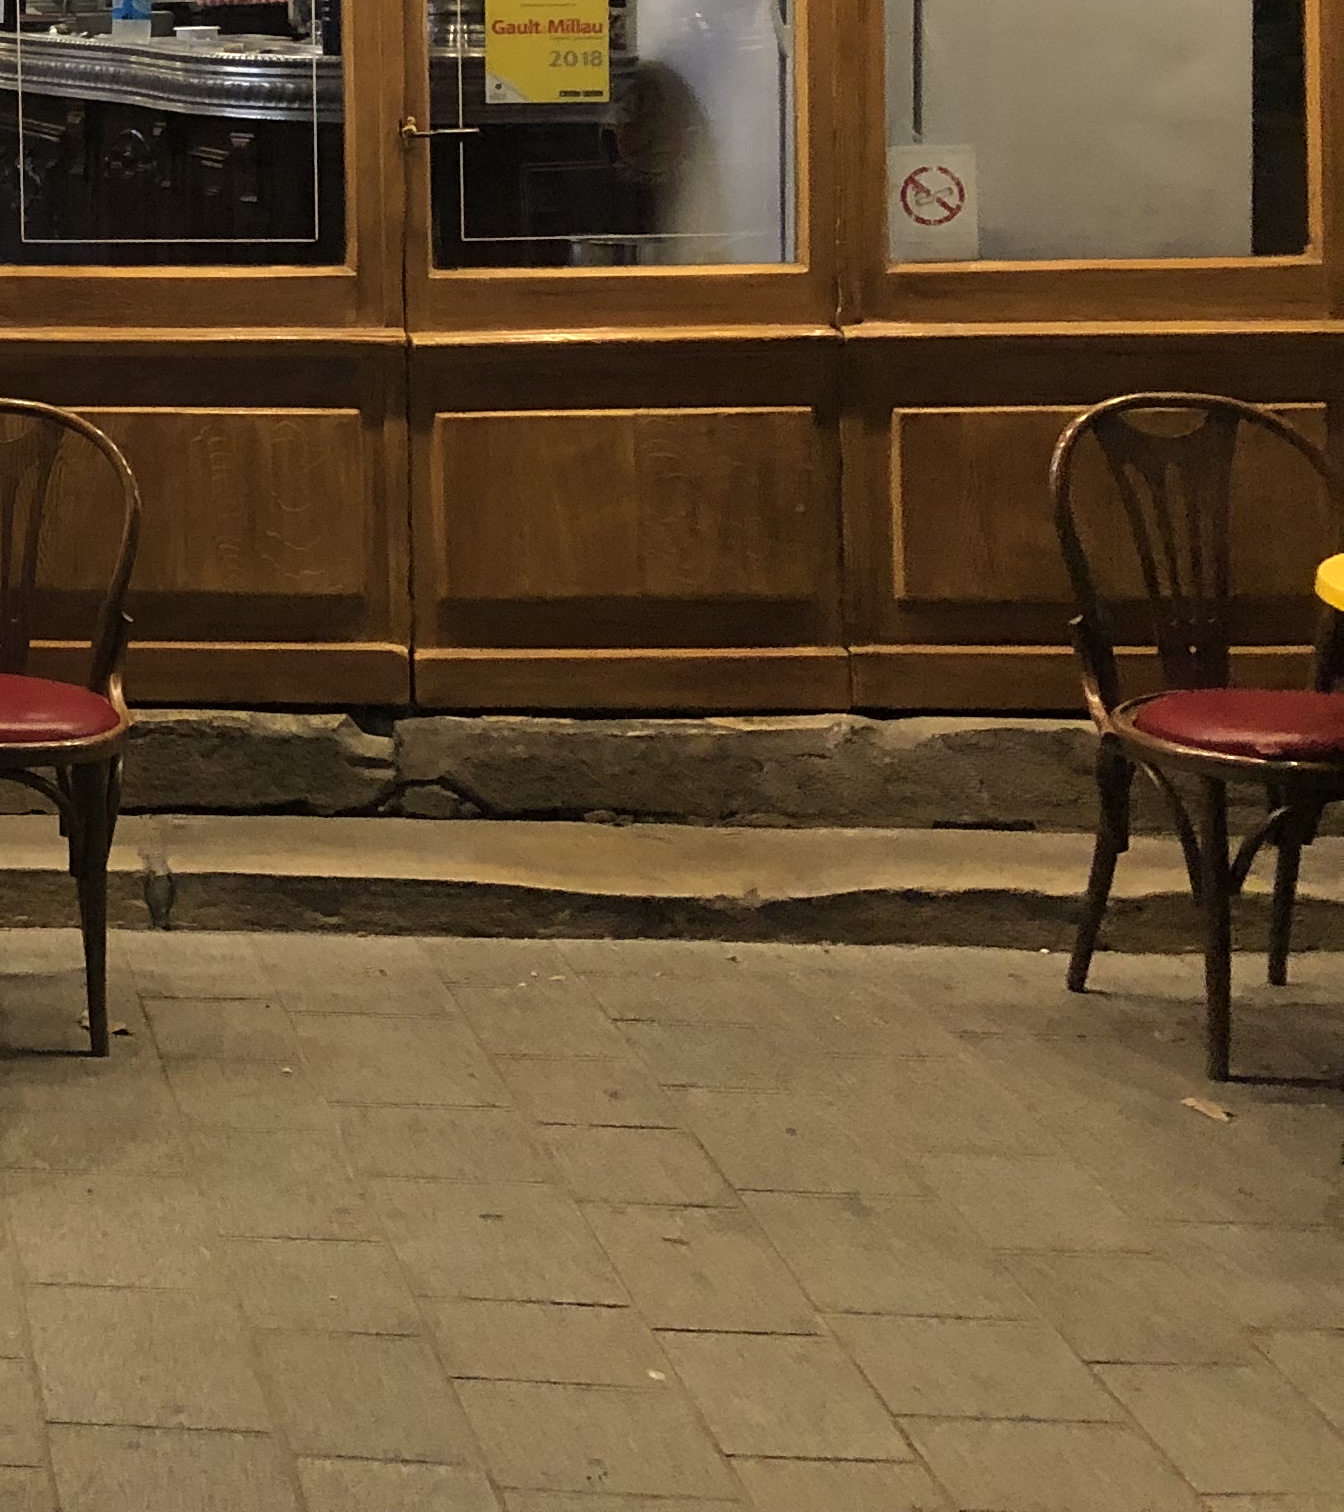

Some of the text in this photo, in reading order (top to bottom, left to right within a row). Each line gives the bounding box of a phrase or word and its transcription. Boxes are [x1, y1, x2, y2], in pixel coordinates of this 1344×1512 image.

[492, 18, 603, 35] Gault Millau
[548, 50, 603, 68] 2018
